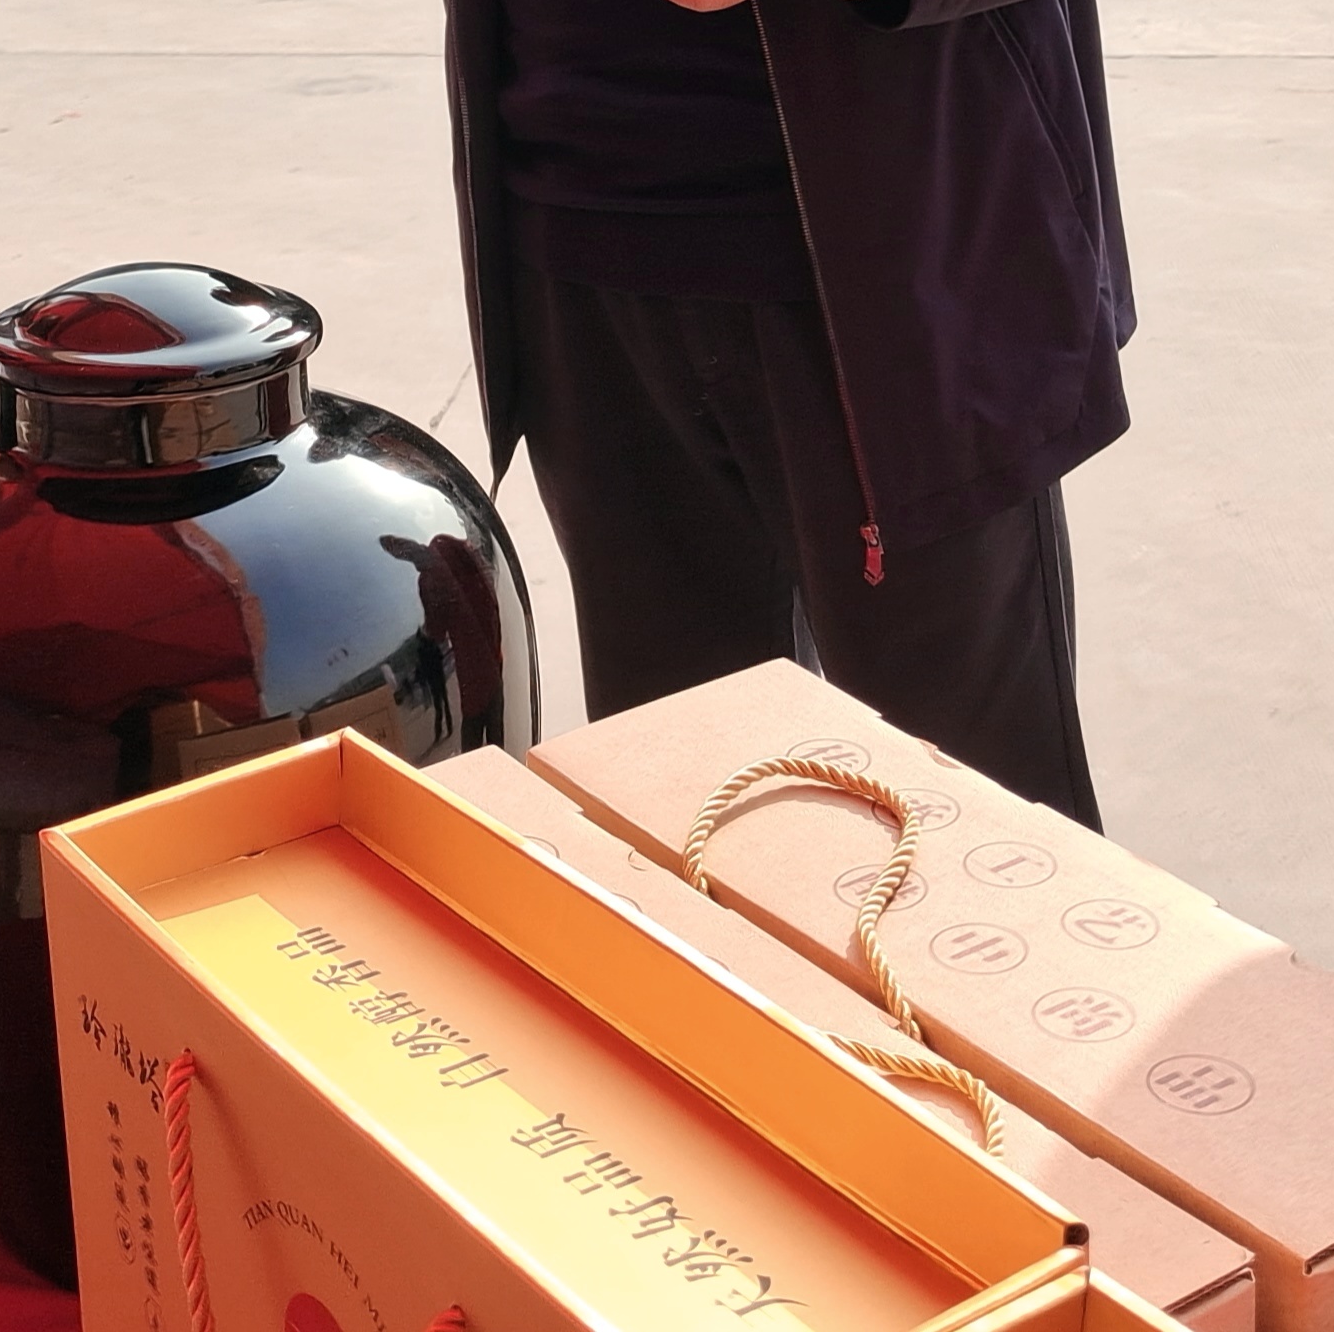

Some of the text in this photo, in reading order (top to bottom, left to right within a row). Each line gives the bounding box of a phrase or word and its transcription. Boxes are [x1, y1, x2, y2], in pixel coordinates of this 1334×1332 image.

[276, 926, 509, 1089] 自然醇香品
[242, 1198, 274, 1230] TIAN
[275, 1199, 324, 1244] QUAN
[329, 1241, 360, 1290] HEI
[510, 1112, 810, 1318] 天然好品质
